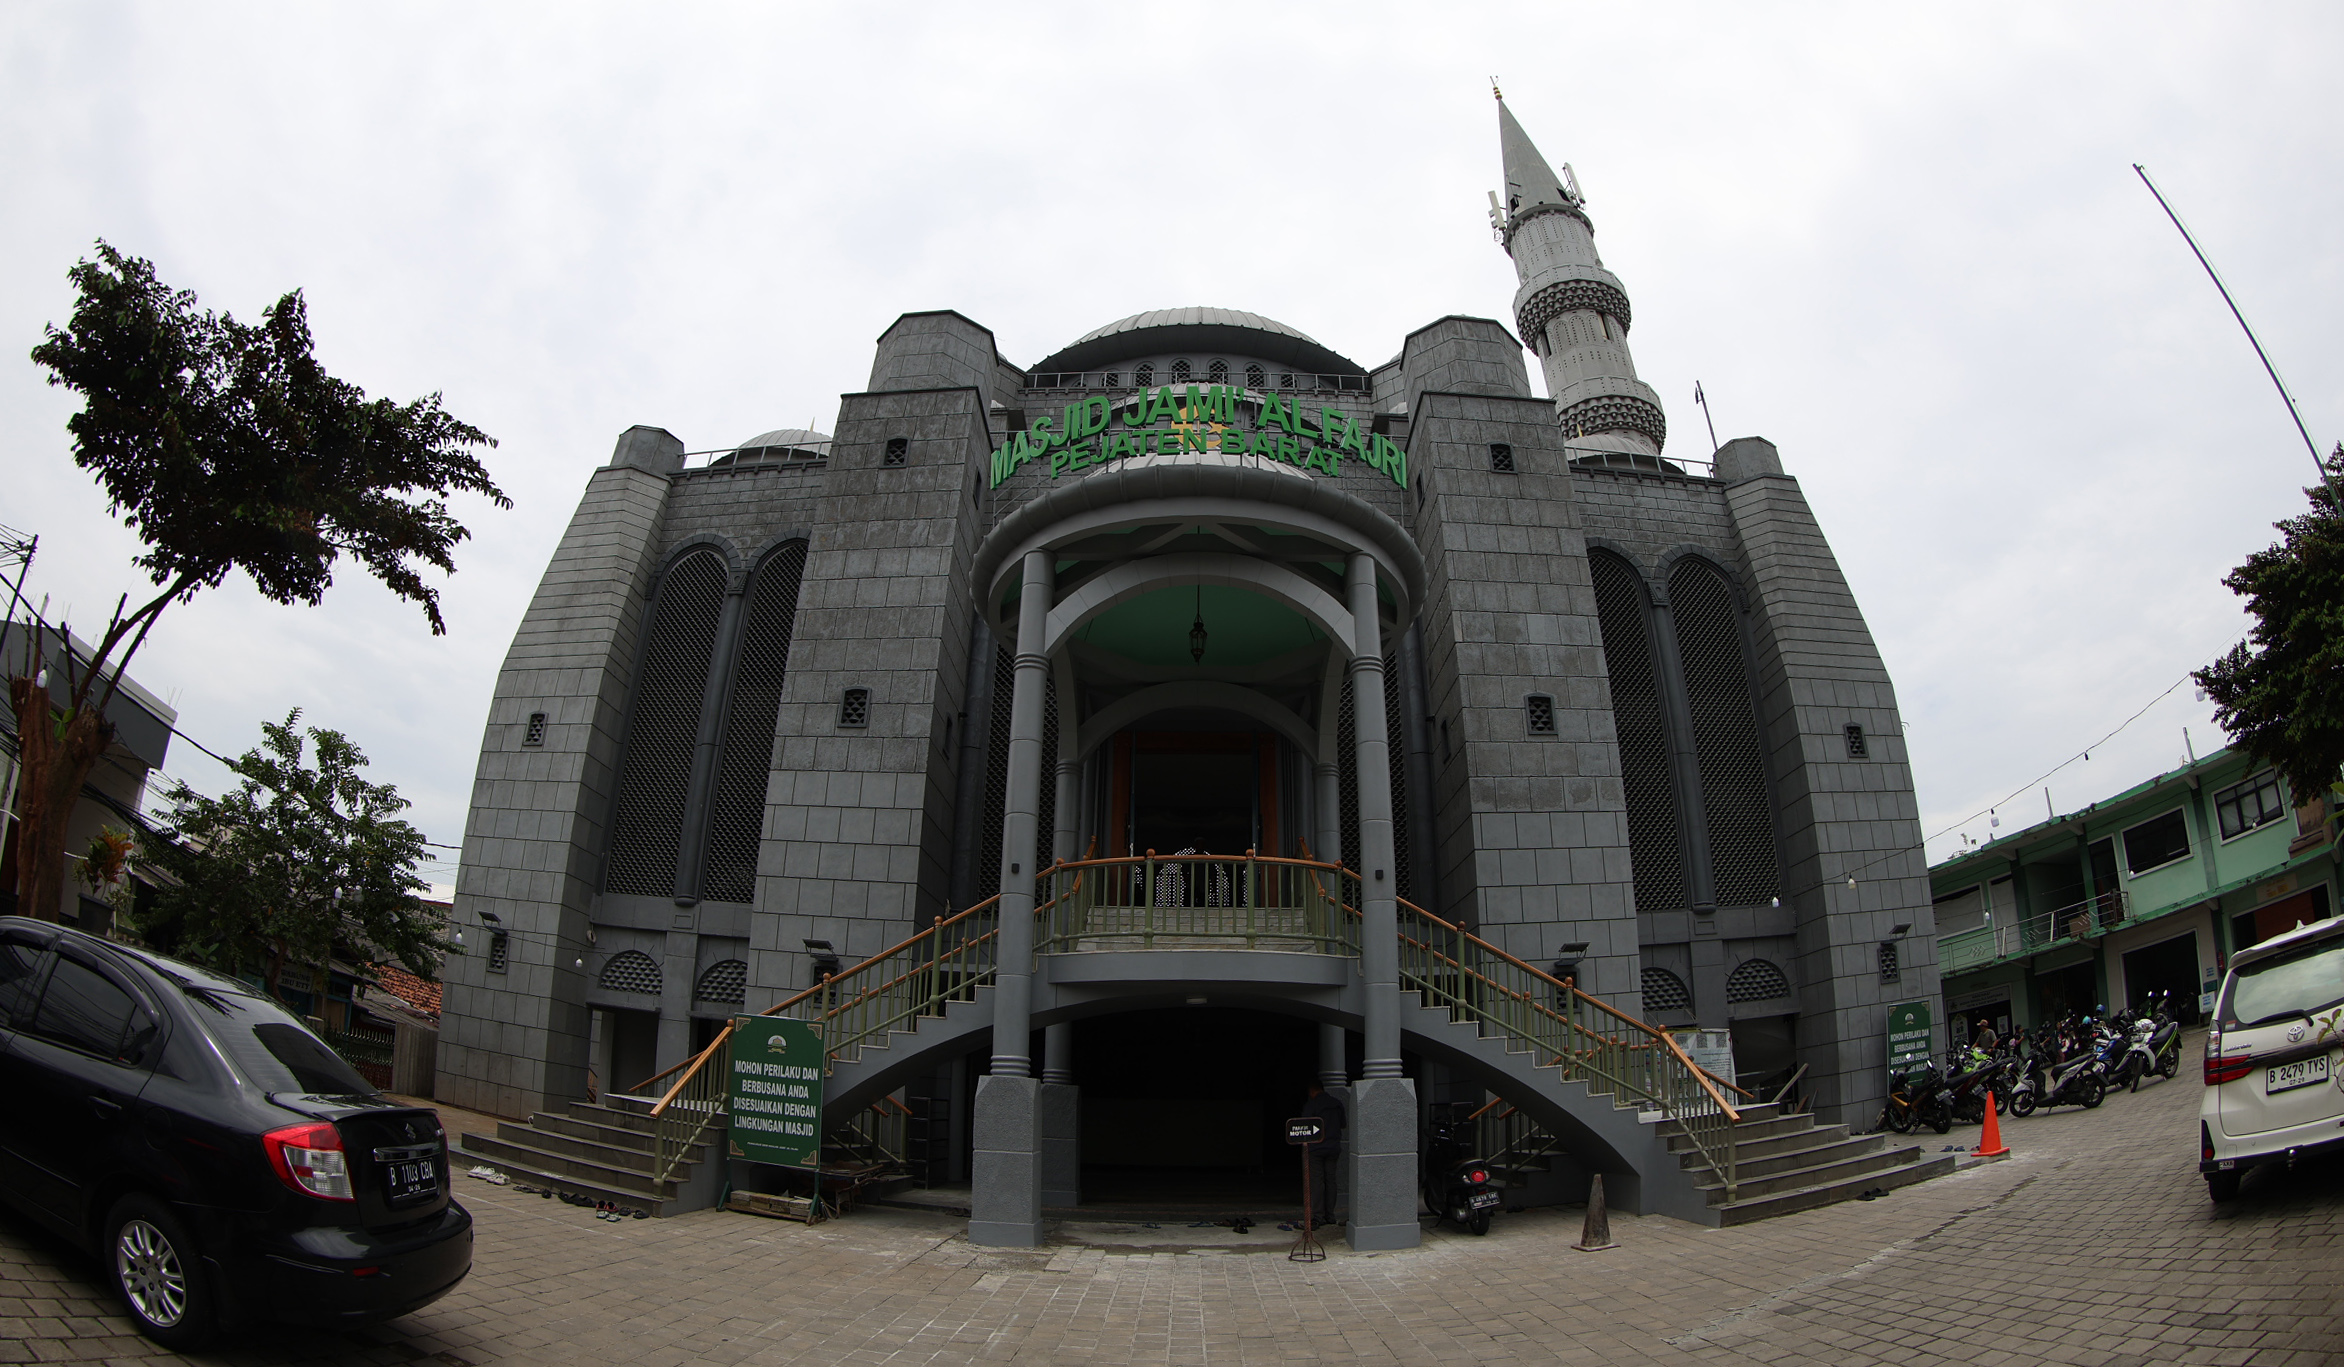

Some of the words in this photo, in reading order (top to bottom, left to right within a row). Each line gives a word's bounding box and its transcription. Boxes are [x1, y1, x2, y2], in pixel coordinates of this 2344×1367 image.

[990, 395, 1111, 490] MASJID
[1050, 428, 1207, 479] PEJATEN
[1221, 429, 1344, 477] BARAT
[281, 969, 311, 982] WARUNG
[734, 1060, 762, 1075] MOHON
[764, 1063, 801, 1080] PERILAKU
[802, 1067, 819, 1081] DAN
[2270, 1069, 2276, 1084] B
[2280, 1063, 2304, 1081] 2479
[2307, 1057, 2325, 1074] TYS
[742, 1079, 786, 1097] BERBUSANA
[788, 1084, 809, 1099] ANDA
[734, 1097, 783, 1115] DISESUAIKAN
[784, 1102, 817, 1118] DENGAN
[734, 1115, 784, 1134] LINGKUNGAN
[785, 1122, 814, 1137] MASJID
[390, 1166, 397, 1186] B
[401, 1164, 419, 1183] 1103
[420, 1161, 434, 1180] CBA
